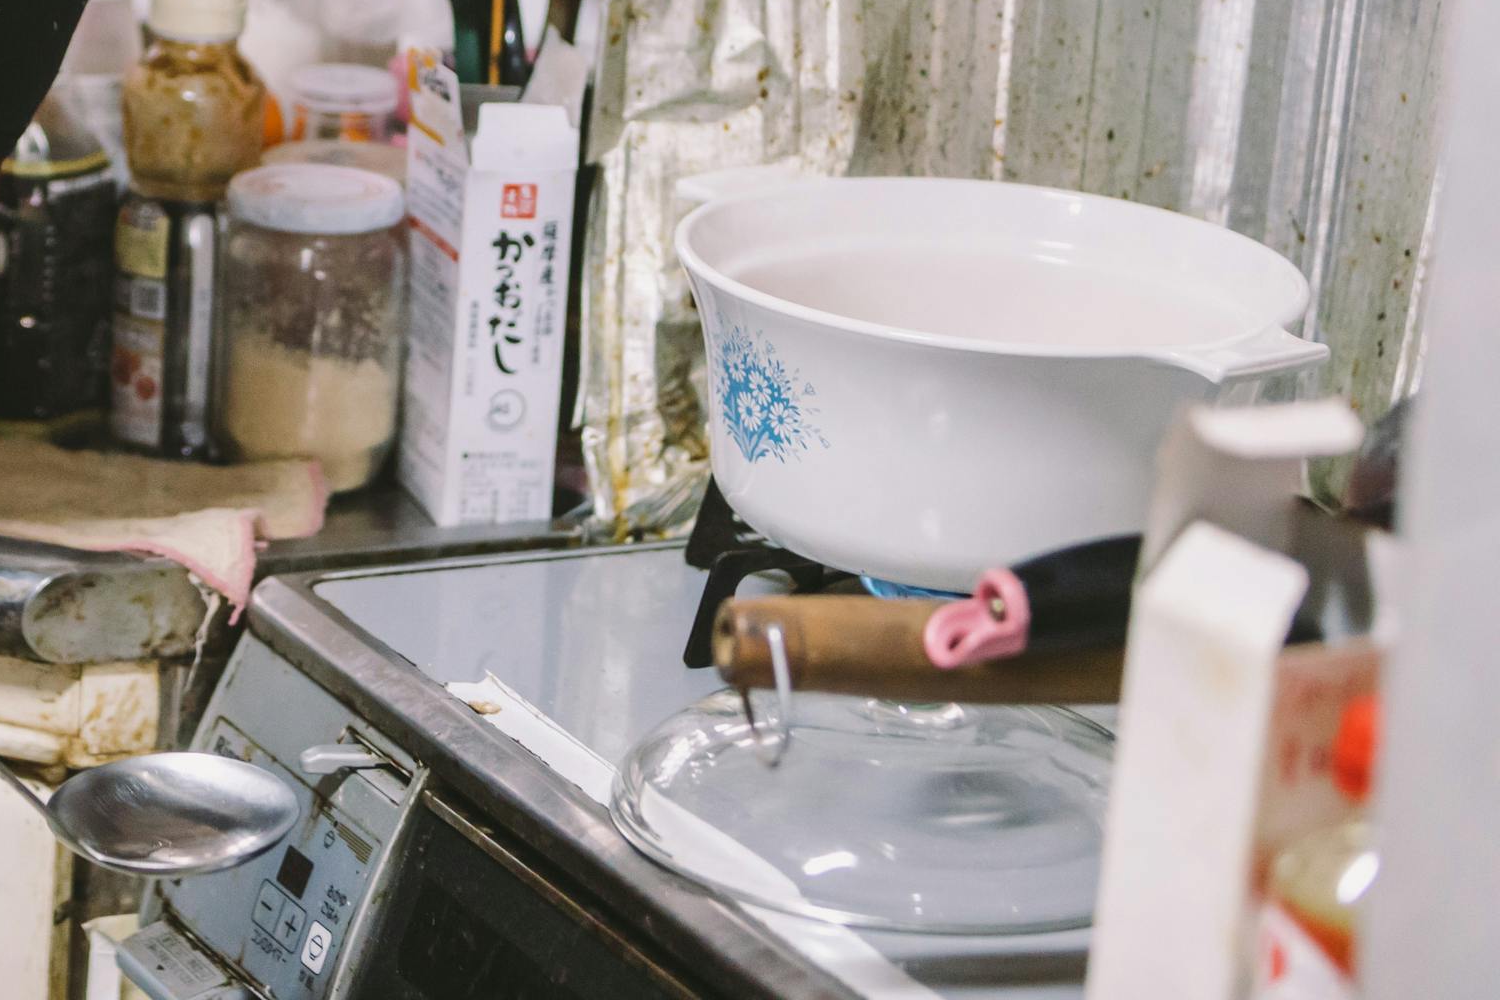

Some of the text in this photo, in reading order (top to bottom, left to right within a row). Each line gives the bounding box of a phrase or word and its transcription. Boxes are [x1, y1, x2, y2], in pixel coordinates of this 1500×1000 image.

[488, 229, 535, 375] かつおだし
